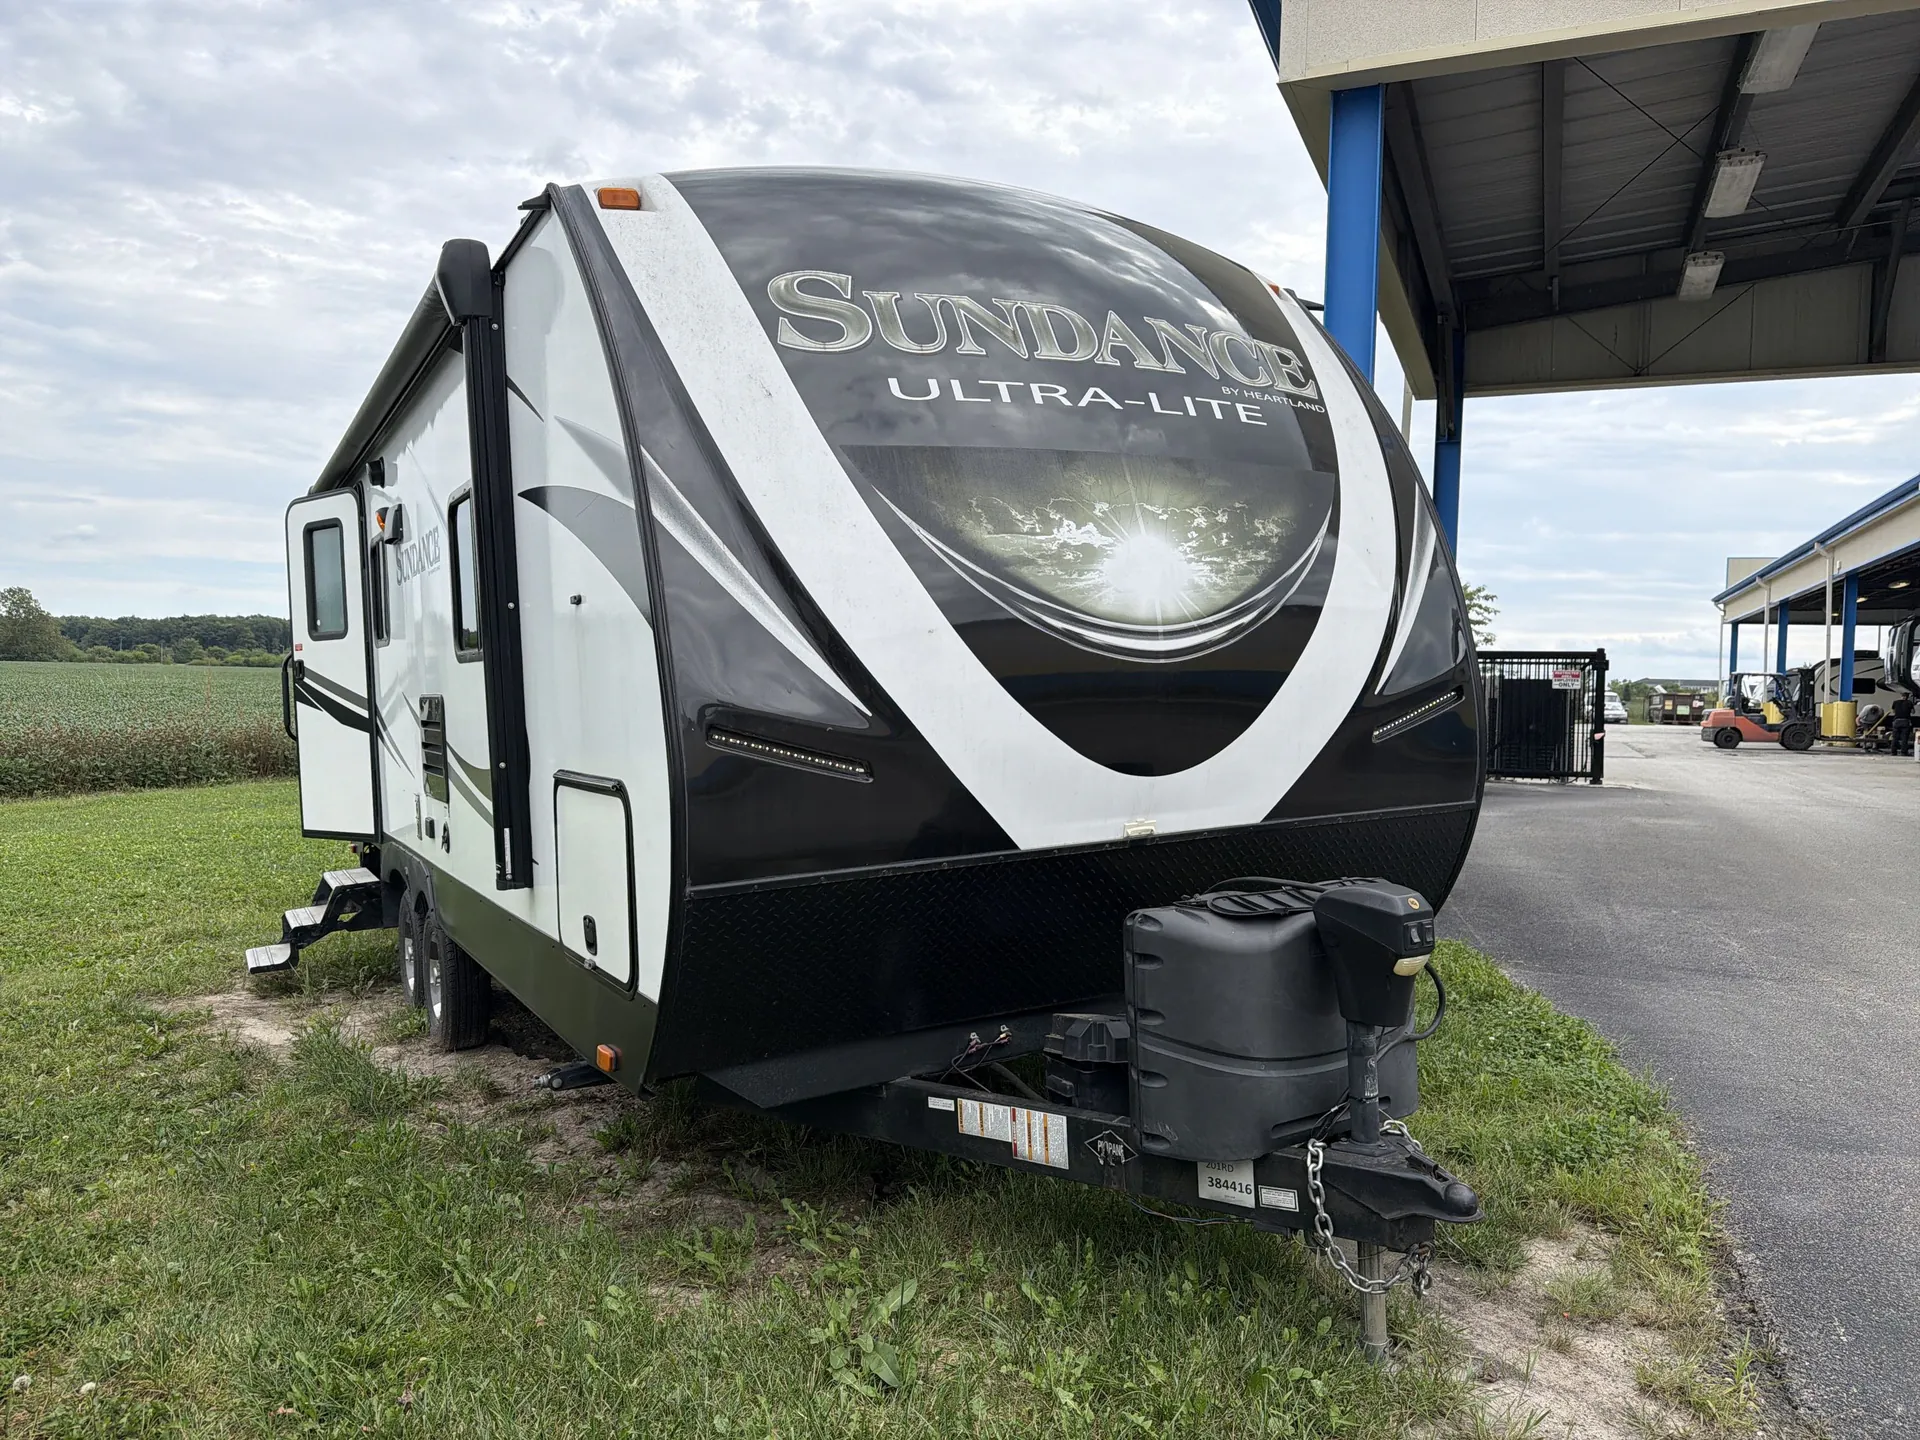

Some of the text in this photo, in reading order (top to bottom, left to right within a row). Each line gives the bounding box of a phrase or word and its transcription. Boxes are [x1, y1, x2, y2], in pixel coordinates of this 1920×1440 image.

[767, 269, 1318, 400] SUNDANCE
[887, 377, 1268, 426] ULTRA-LITE
[1221, 386, 1326, 413] BY HEARTLAND
[396, 526, 440, 586] SUNDANCE
[1206, 1162, 1234, 1173] 201RD
[1207, 1176, 1252, 1195] 384416
